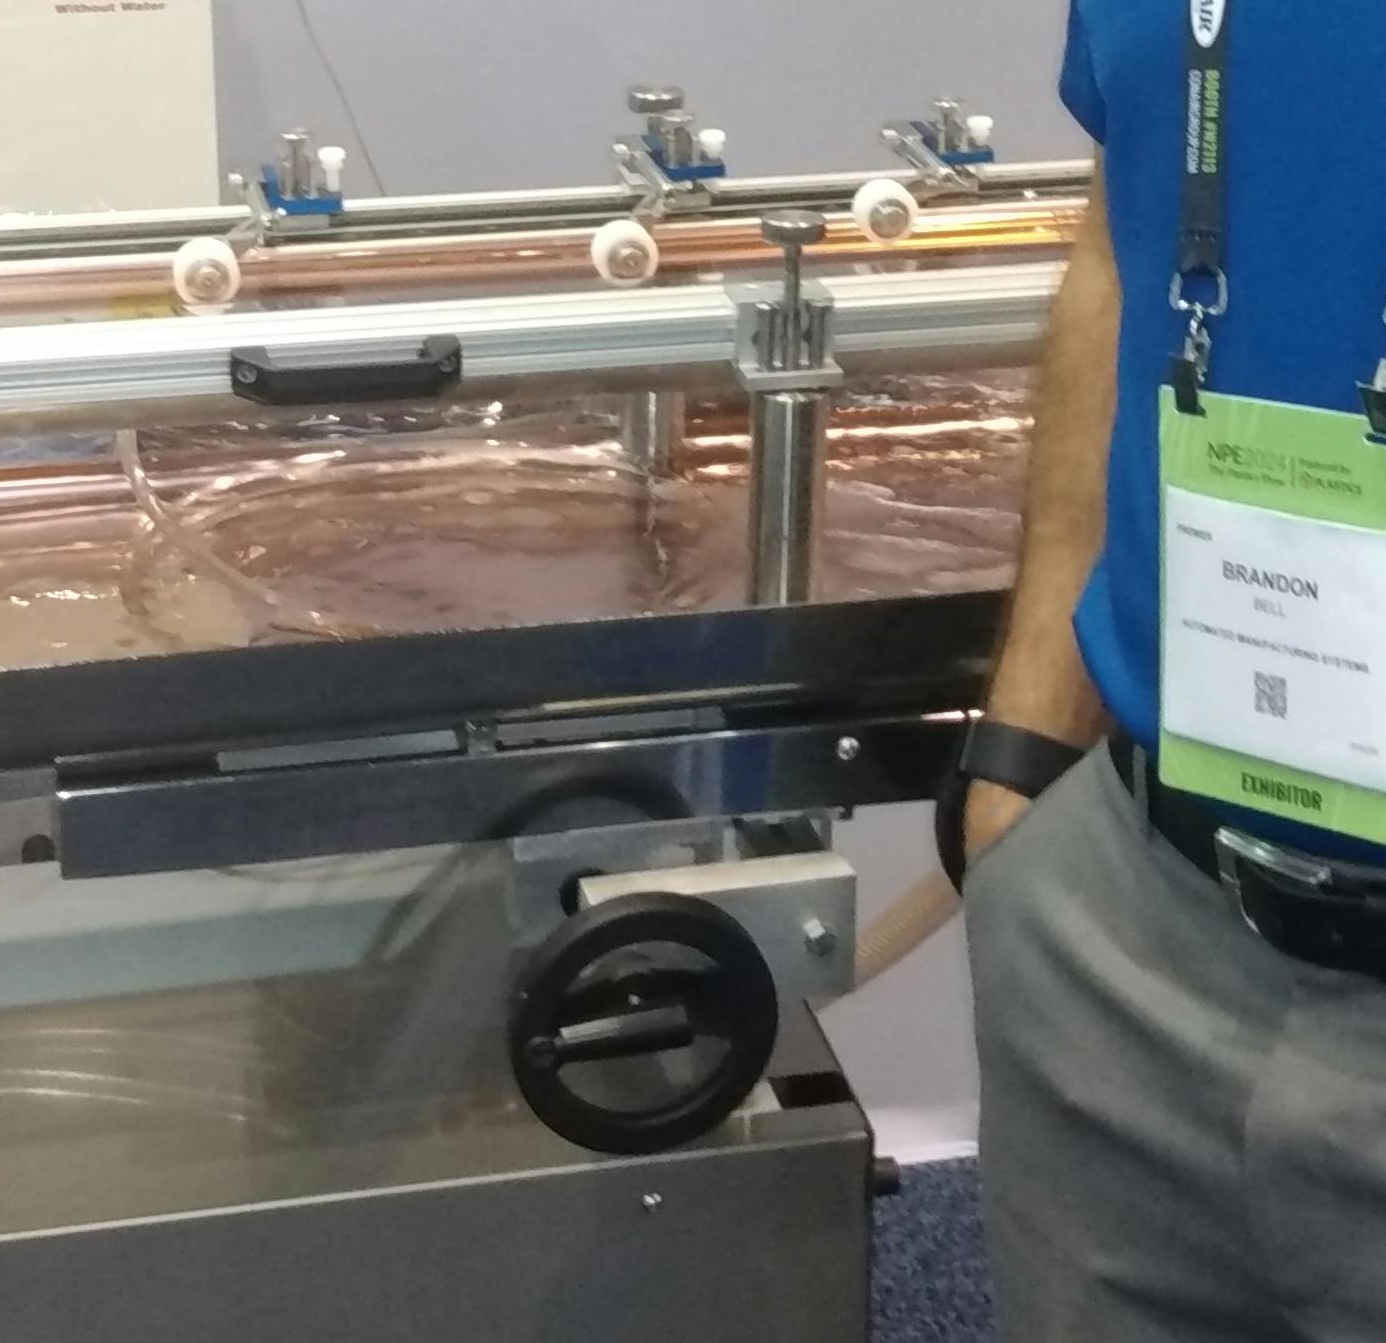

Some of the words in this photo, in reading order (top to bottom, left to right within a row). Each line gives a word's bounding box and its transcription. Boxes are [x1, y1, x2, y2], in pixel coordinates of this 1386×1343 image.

[55, 3, 115, 14] Without
[121, 2, 166, 12] Water
[1222, 560, 1319, 601] BRANDON
[1253, 597, 1286, 618] BELL
[1241, 772, 1323, 812] EXHIBITOR
